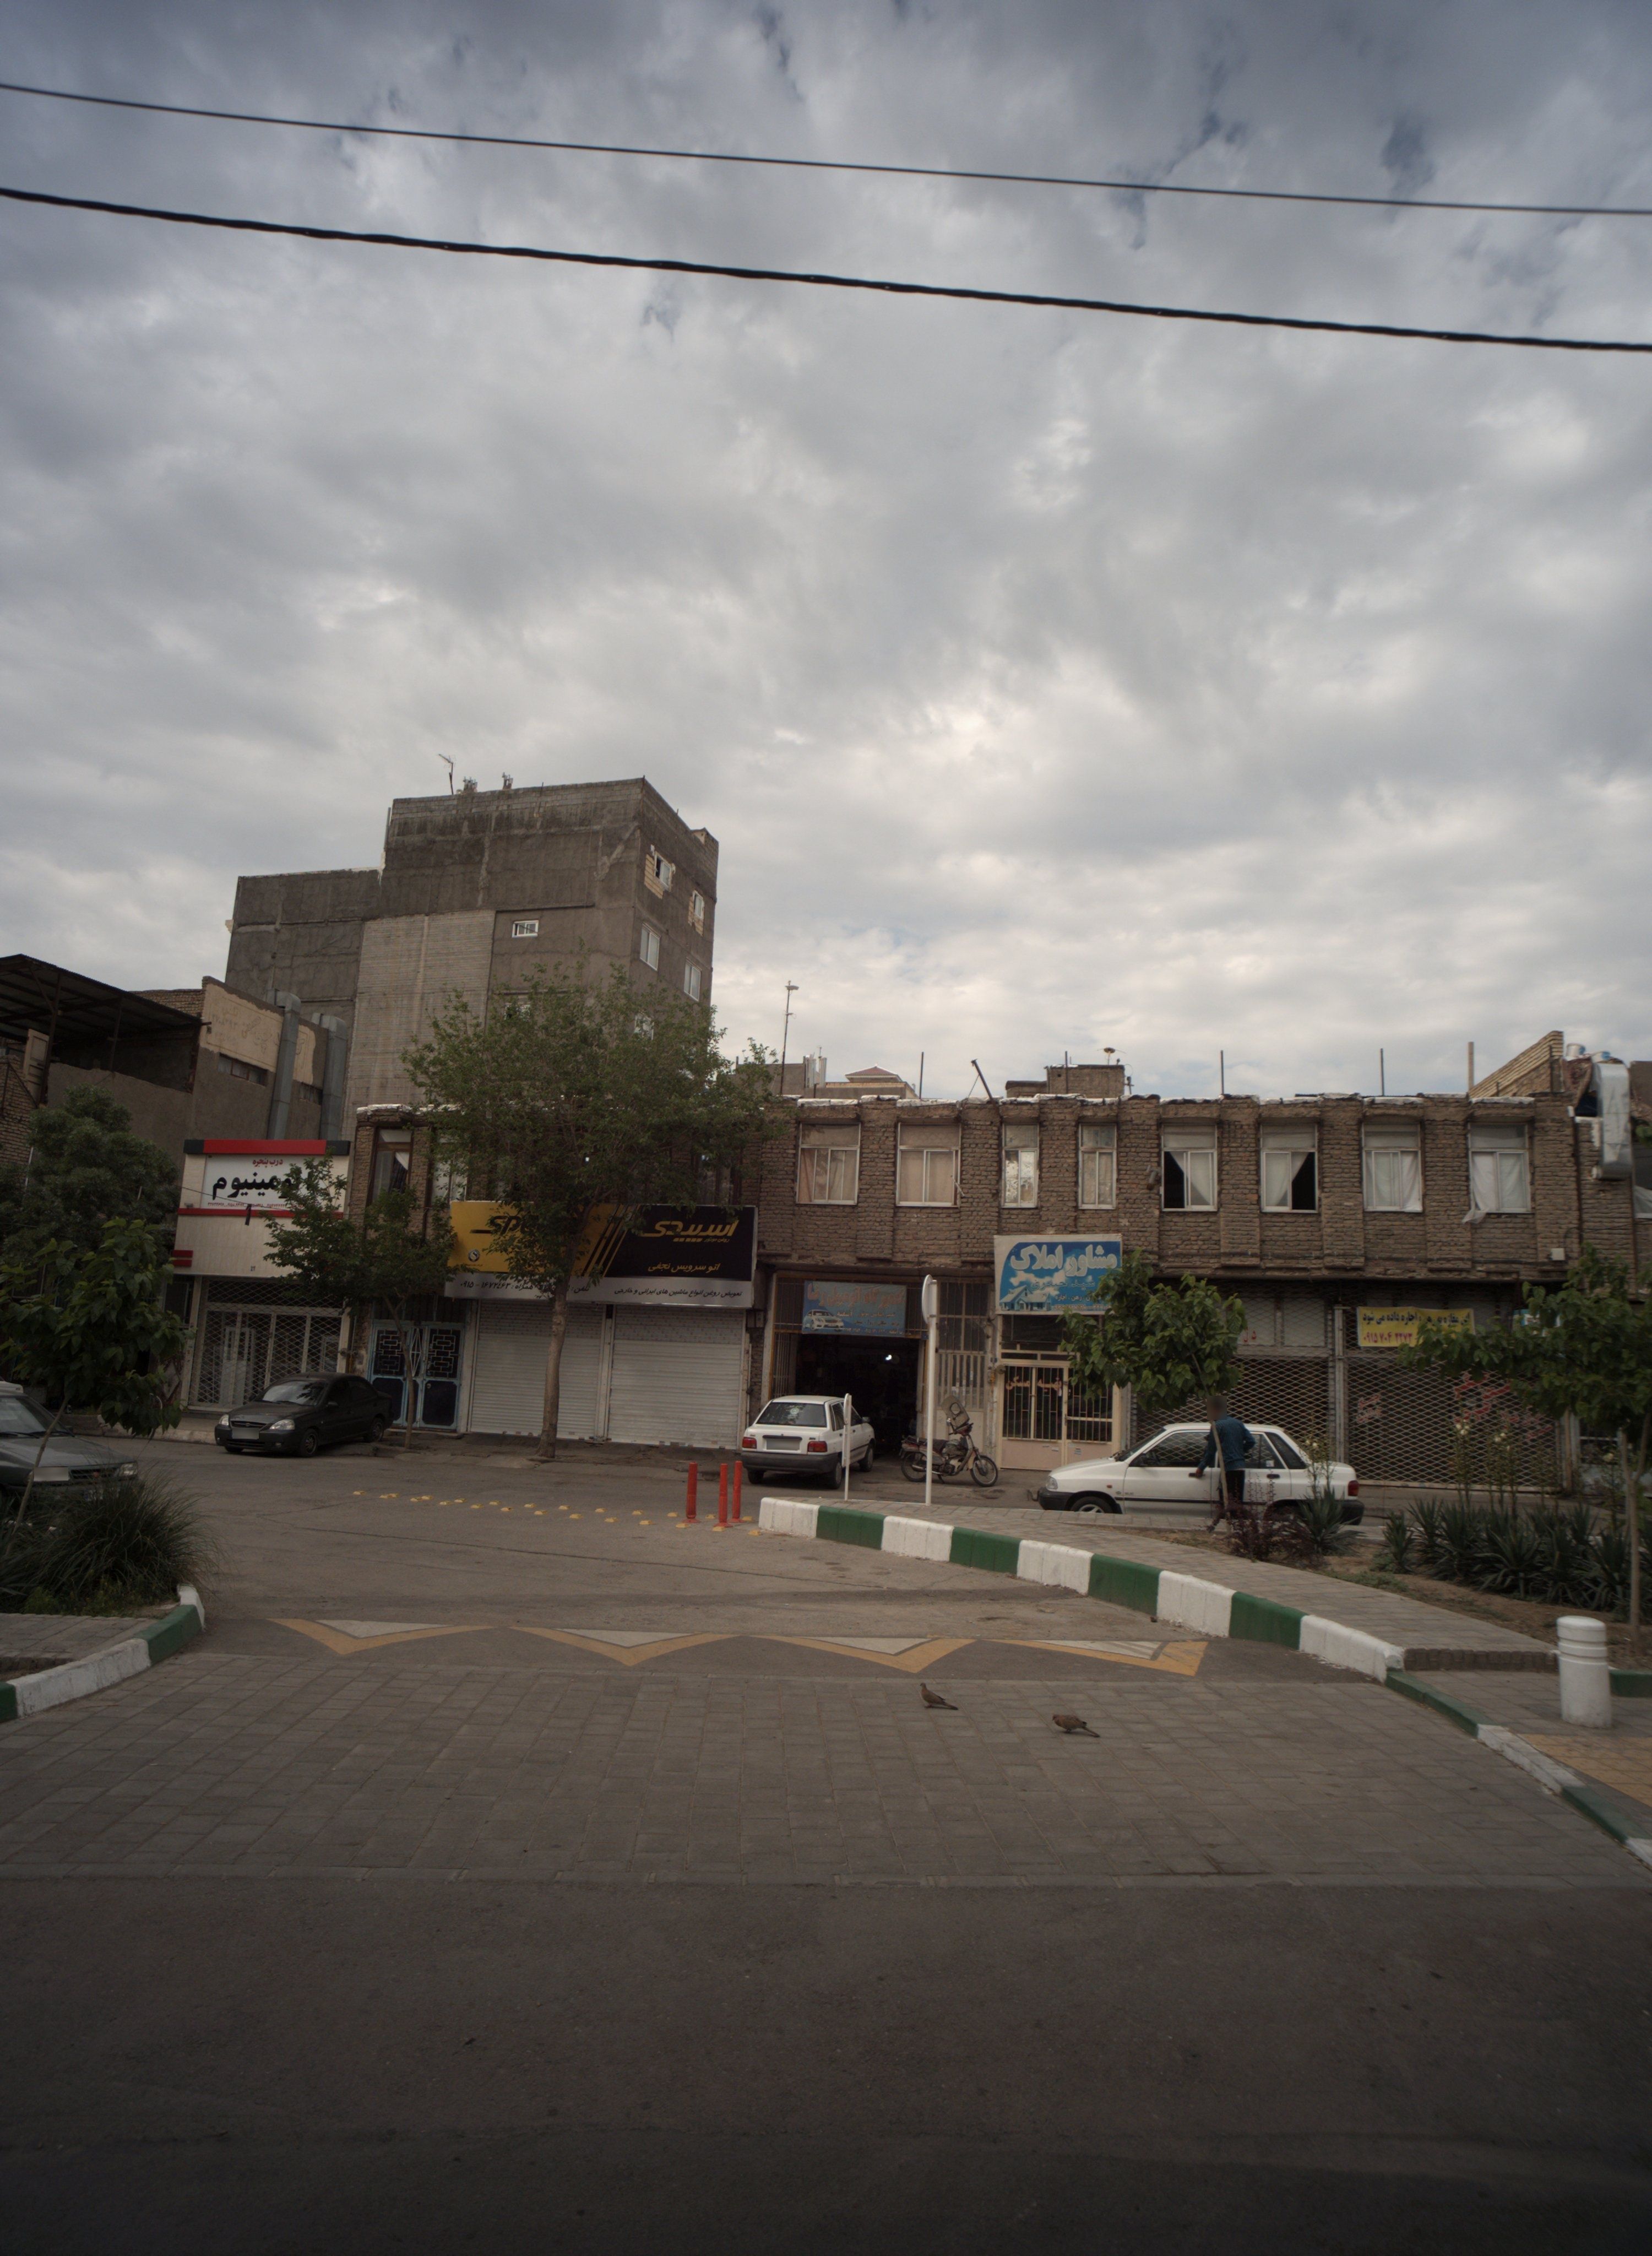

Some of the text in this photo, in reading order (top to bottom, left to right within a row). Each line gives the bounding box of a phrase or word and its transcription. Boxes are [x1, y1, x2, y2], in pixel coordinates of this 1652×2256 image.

[253, 1158, 283, 1169] درب پنجره
[1010, 1244, 1117, 1277] مشاور املاک
[648, 1262, 721, 1273] اتو سرویس نجفی
